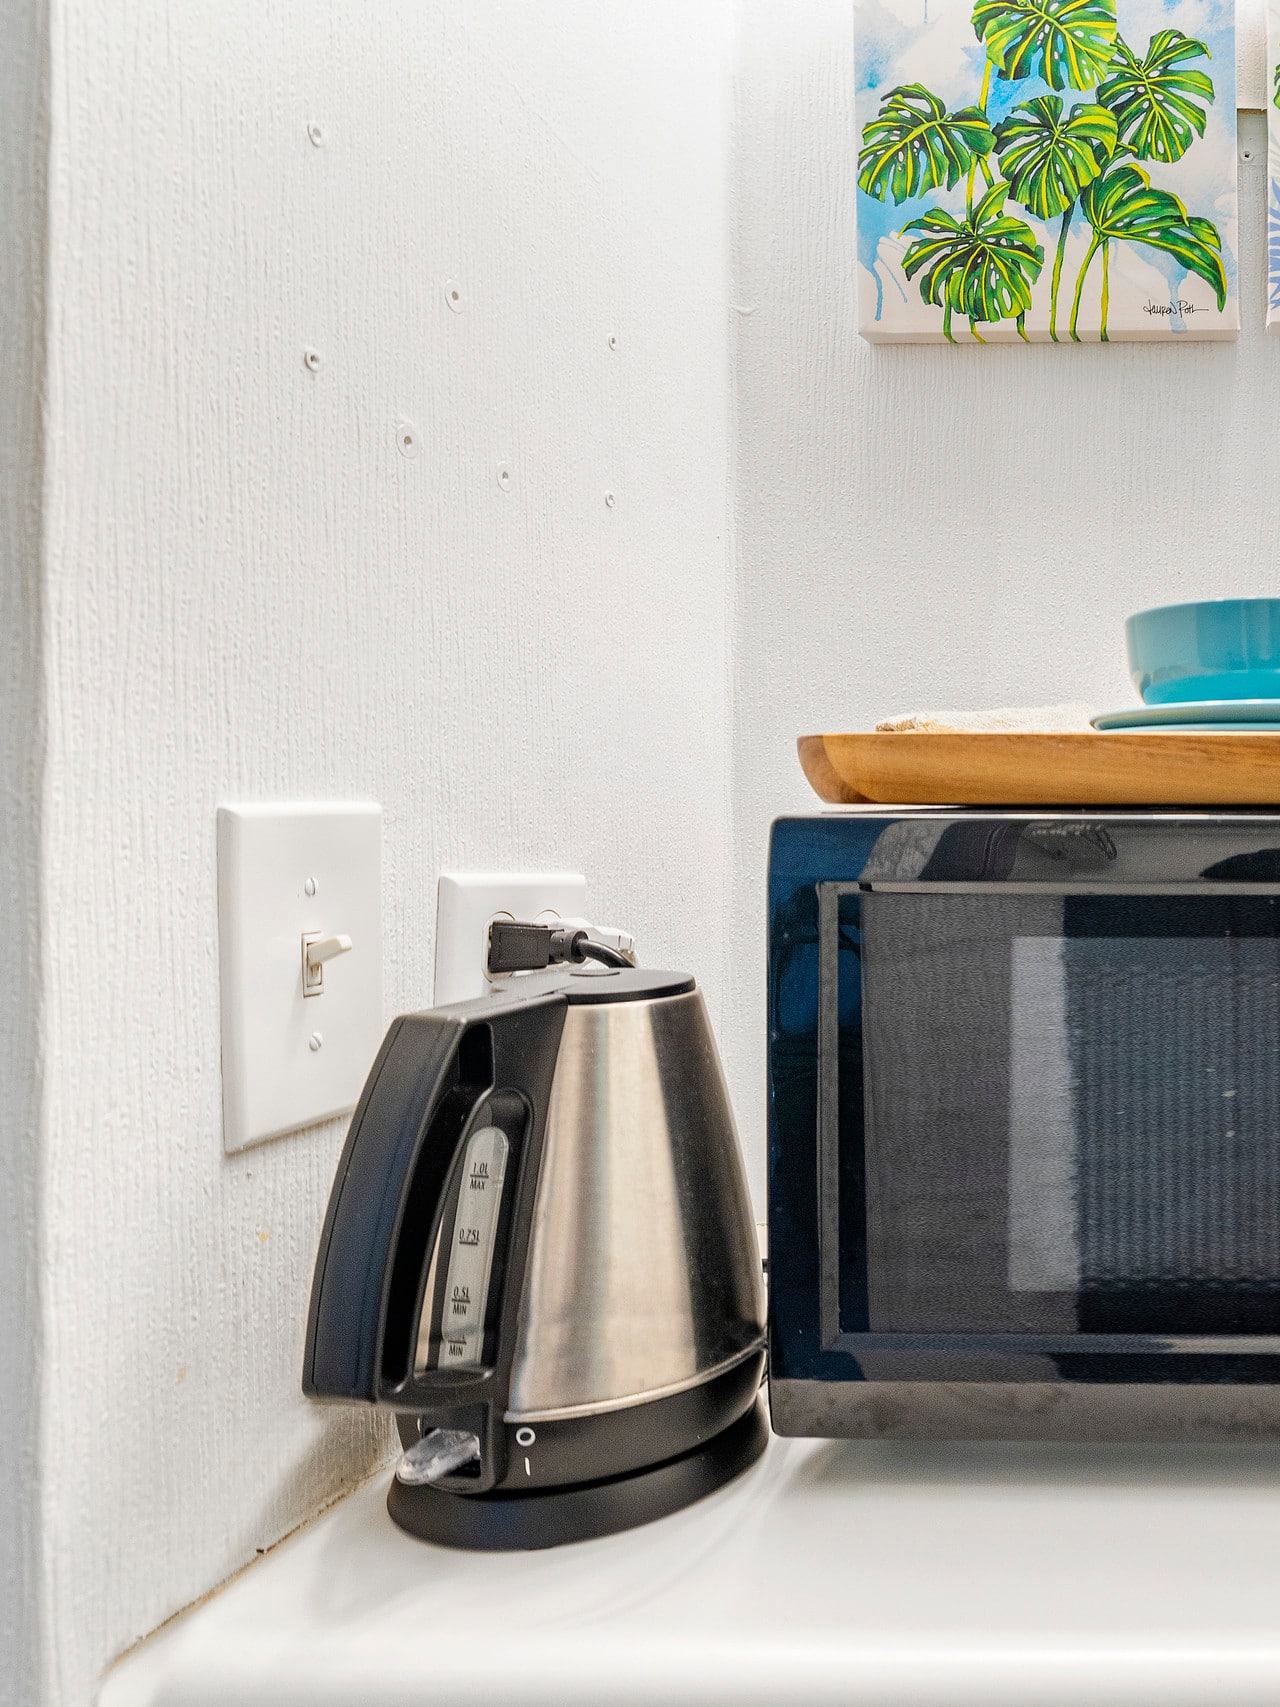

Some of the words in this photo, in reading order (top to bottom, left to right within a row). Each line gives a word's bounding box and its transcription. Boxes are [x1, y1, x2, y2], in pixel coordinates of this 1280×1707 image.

[473, 1162, 489, 1174] 1.0L
[469, 1178, 485, 1191] MAX
[452, 1302, 467, 1316] MIN
